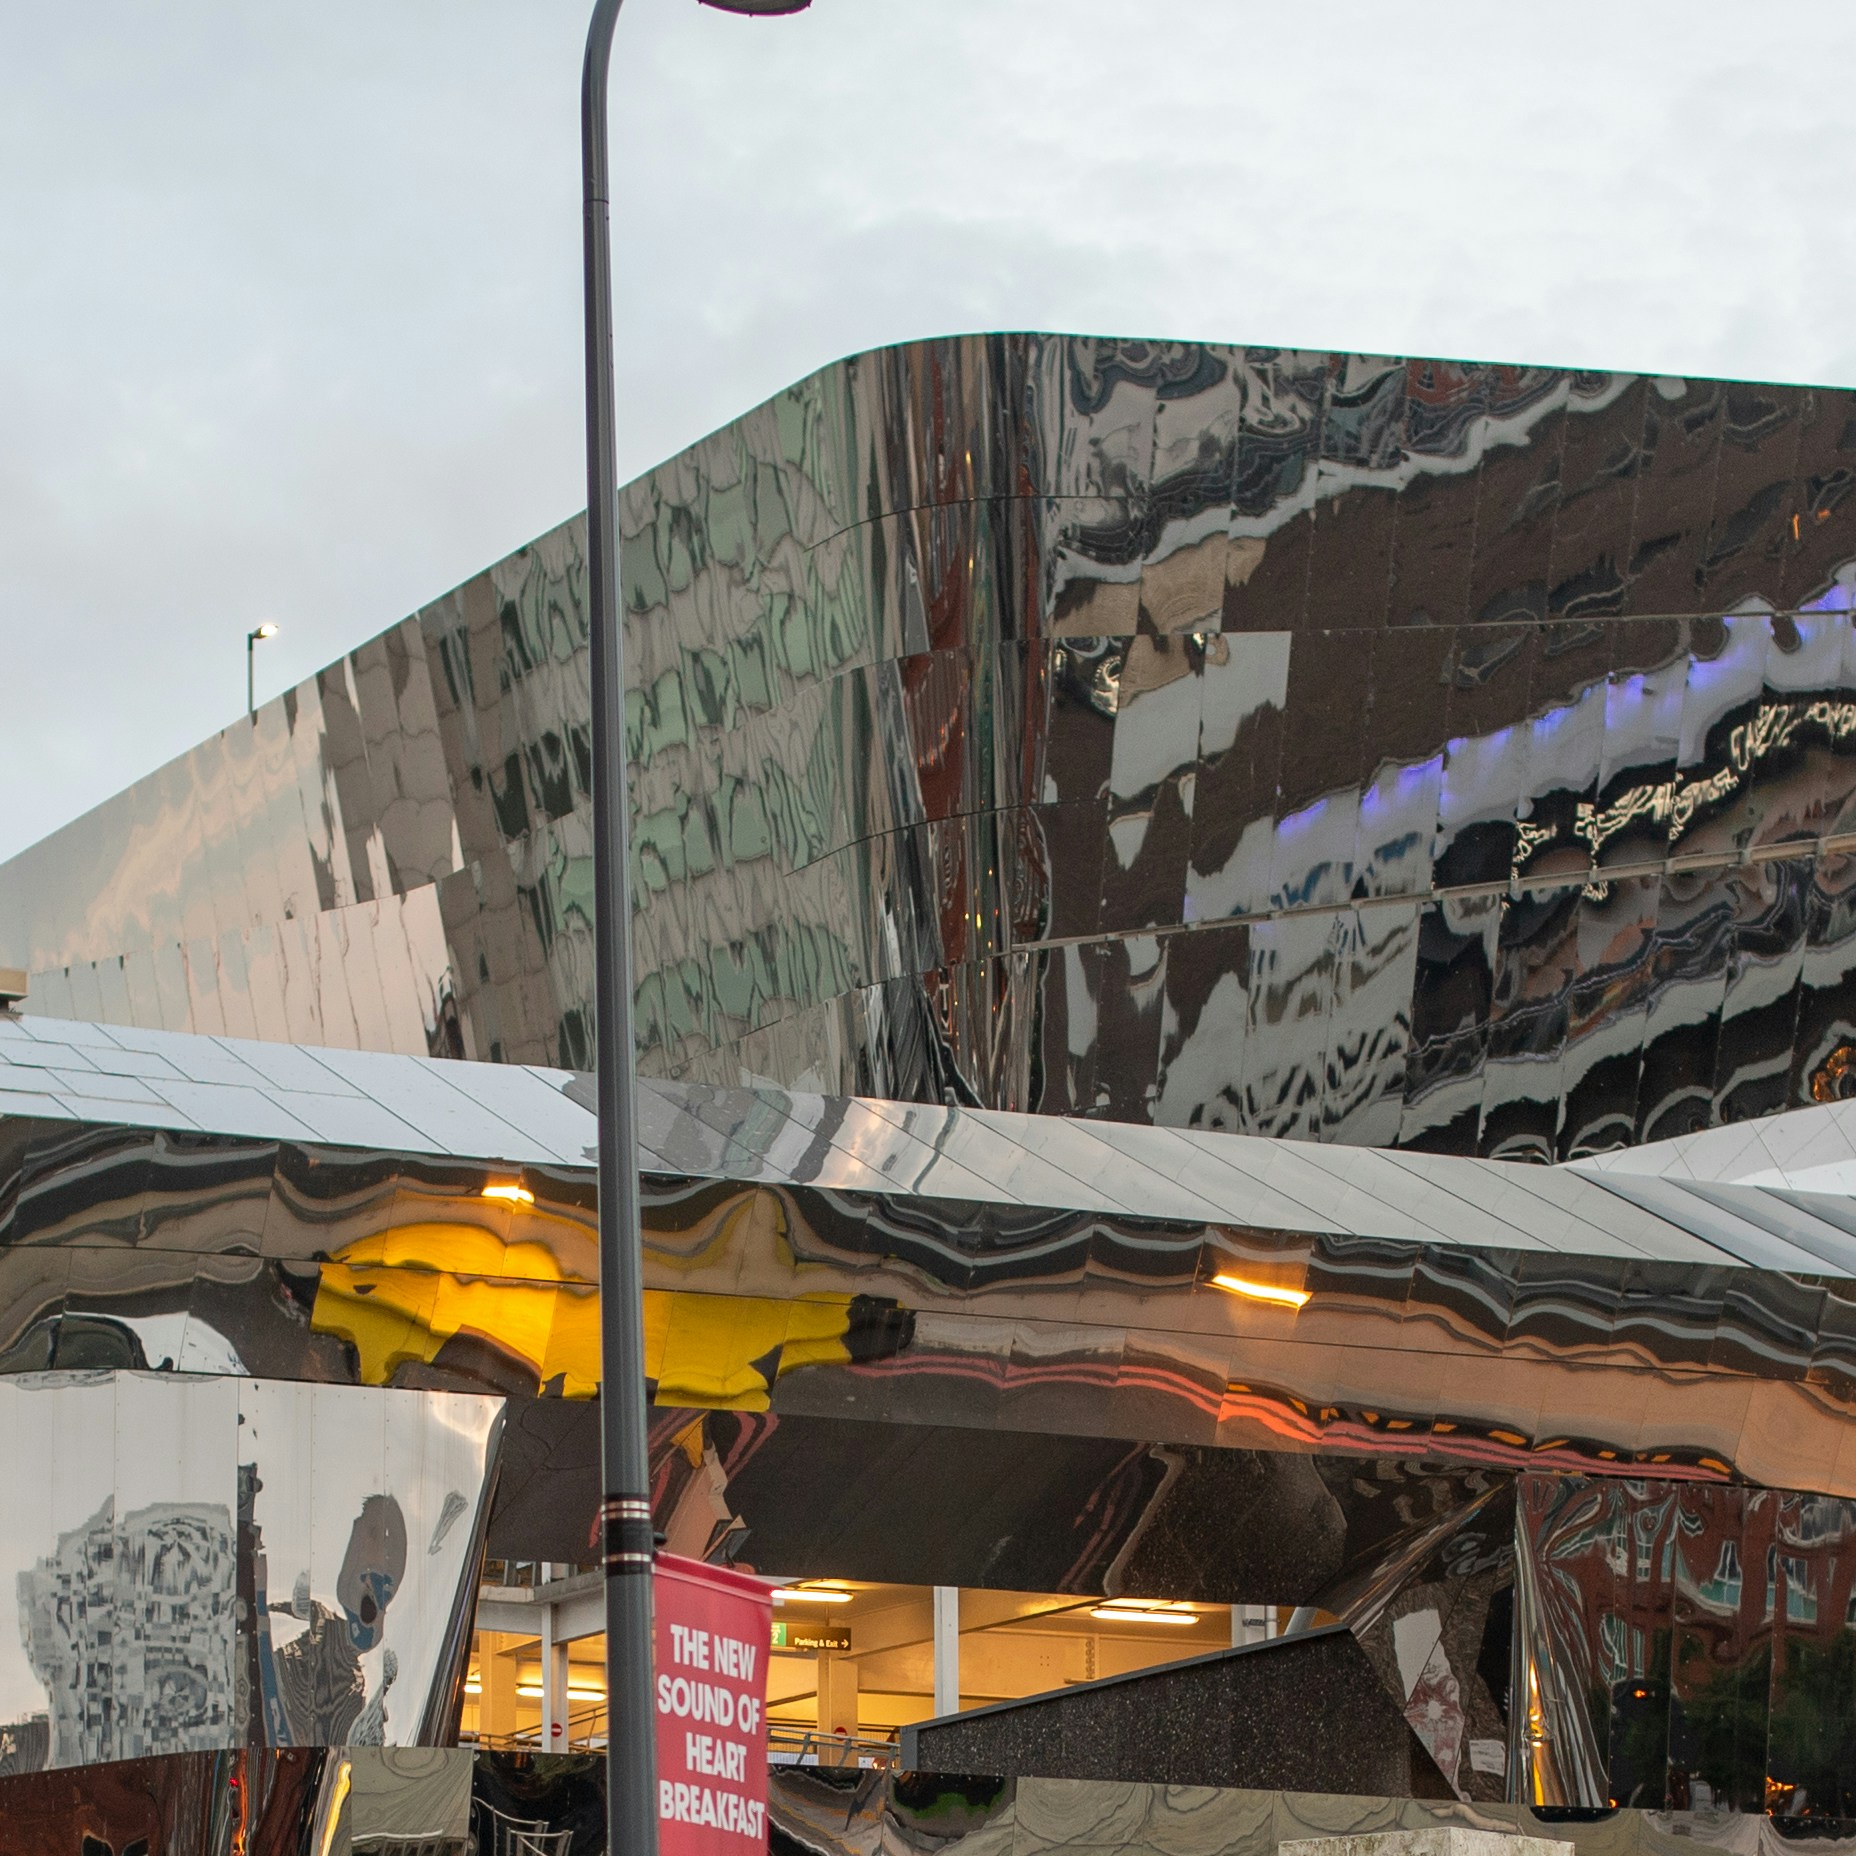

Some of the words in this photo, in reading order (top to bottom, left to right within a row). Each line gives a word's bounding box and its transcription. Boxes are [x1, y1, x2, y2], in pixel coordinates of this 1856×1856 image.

[670, 1624, 709, 1670] THE
[714, 1634, 756, 1682] NEW
[794, 1637, 819, 1648] Parking
[819, 1639, 825, 1647] &
[825, 1640, 838, 1648] Exit
[657, 1673, 734, 1727] SOUND
[737, 1693, 760, 1735] OF
[686, 1732, 746, 1783] HEART
[659, 1779, 765, 1840] BREAKFAST
